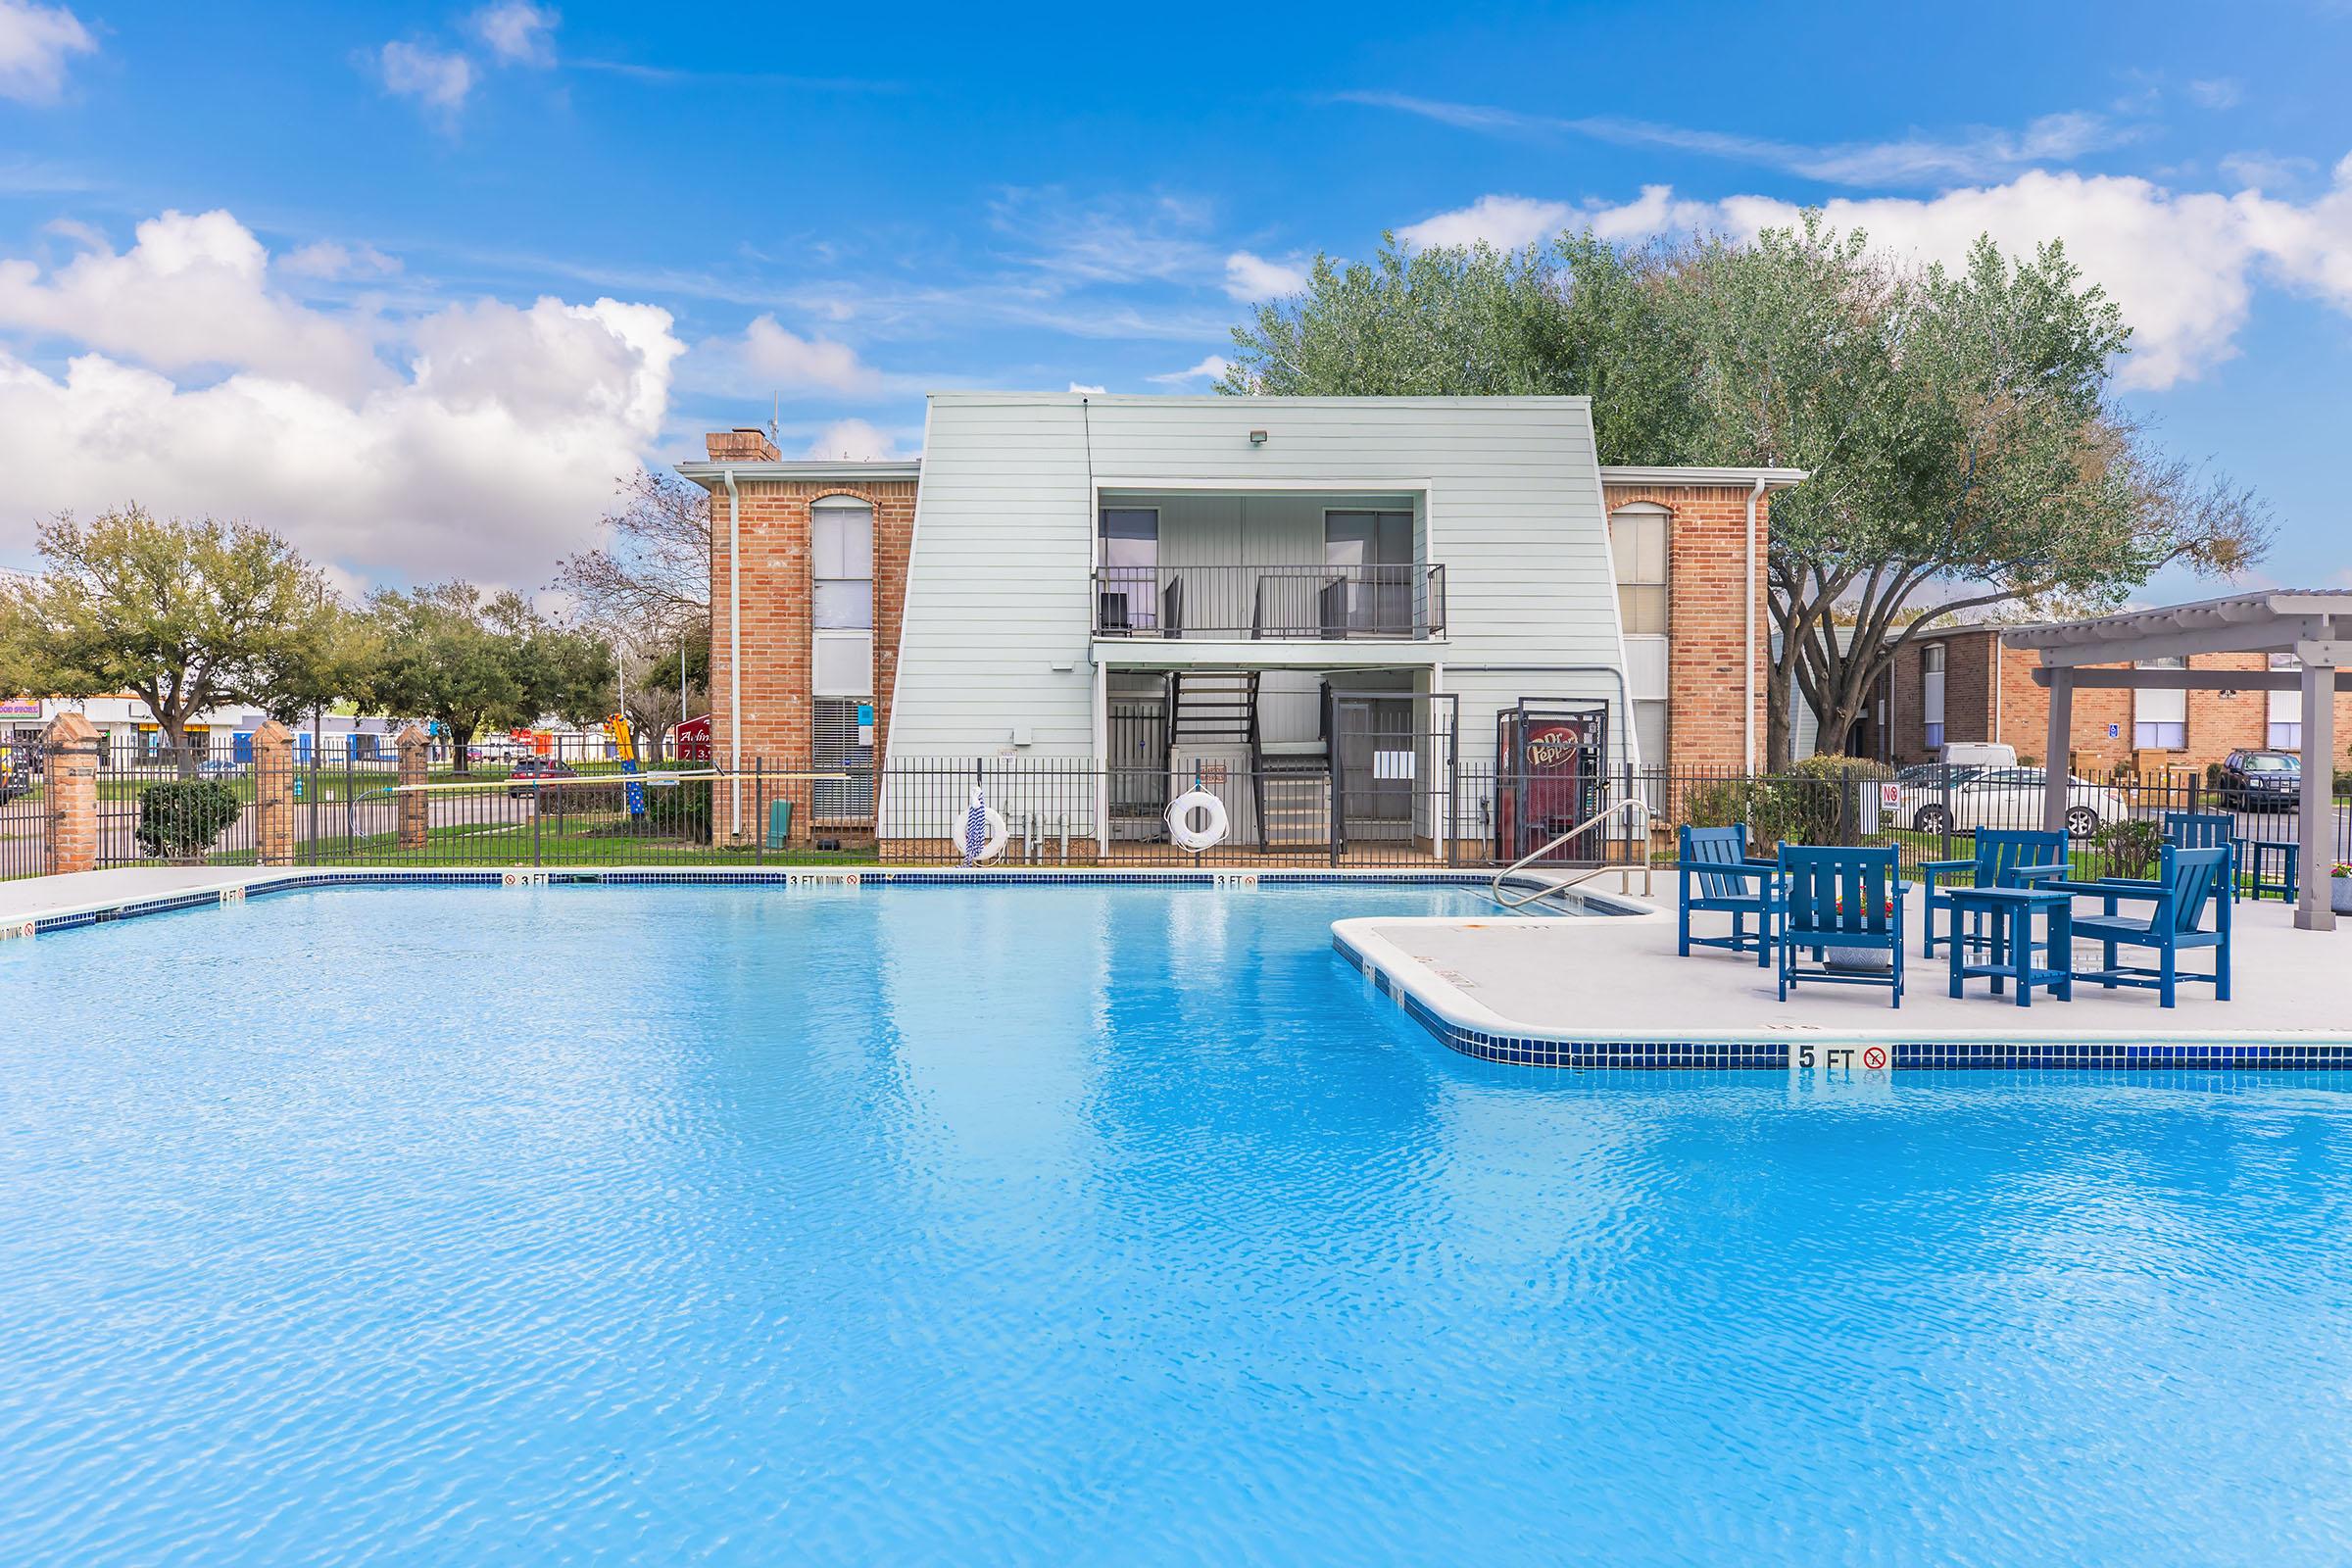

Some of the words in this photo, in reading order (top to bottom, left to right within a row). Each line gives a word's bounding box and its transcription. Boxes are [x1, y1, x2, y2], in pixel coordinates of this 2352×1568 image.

[1544, 733, 1562, 744] Dr
[1884, 786, 1897, 802] NO
[521, 875, 529, 886] 3
[533, 873, 546, 885] FT
[790, 875, 797, 885] 3
[802, 875, 814, 885] FT
[1217, 875, 1225, 885] 3
[1230, 875, 1243, 884] FT
[222, 891, 227, 902] 4
[229, 890, 236, 903] FT
[1799, 1045, 1815, 1068] 5
[1827, 1049, 1855, 1069] FT
